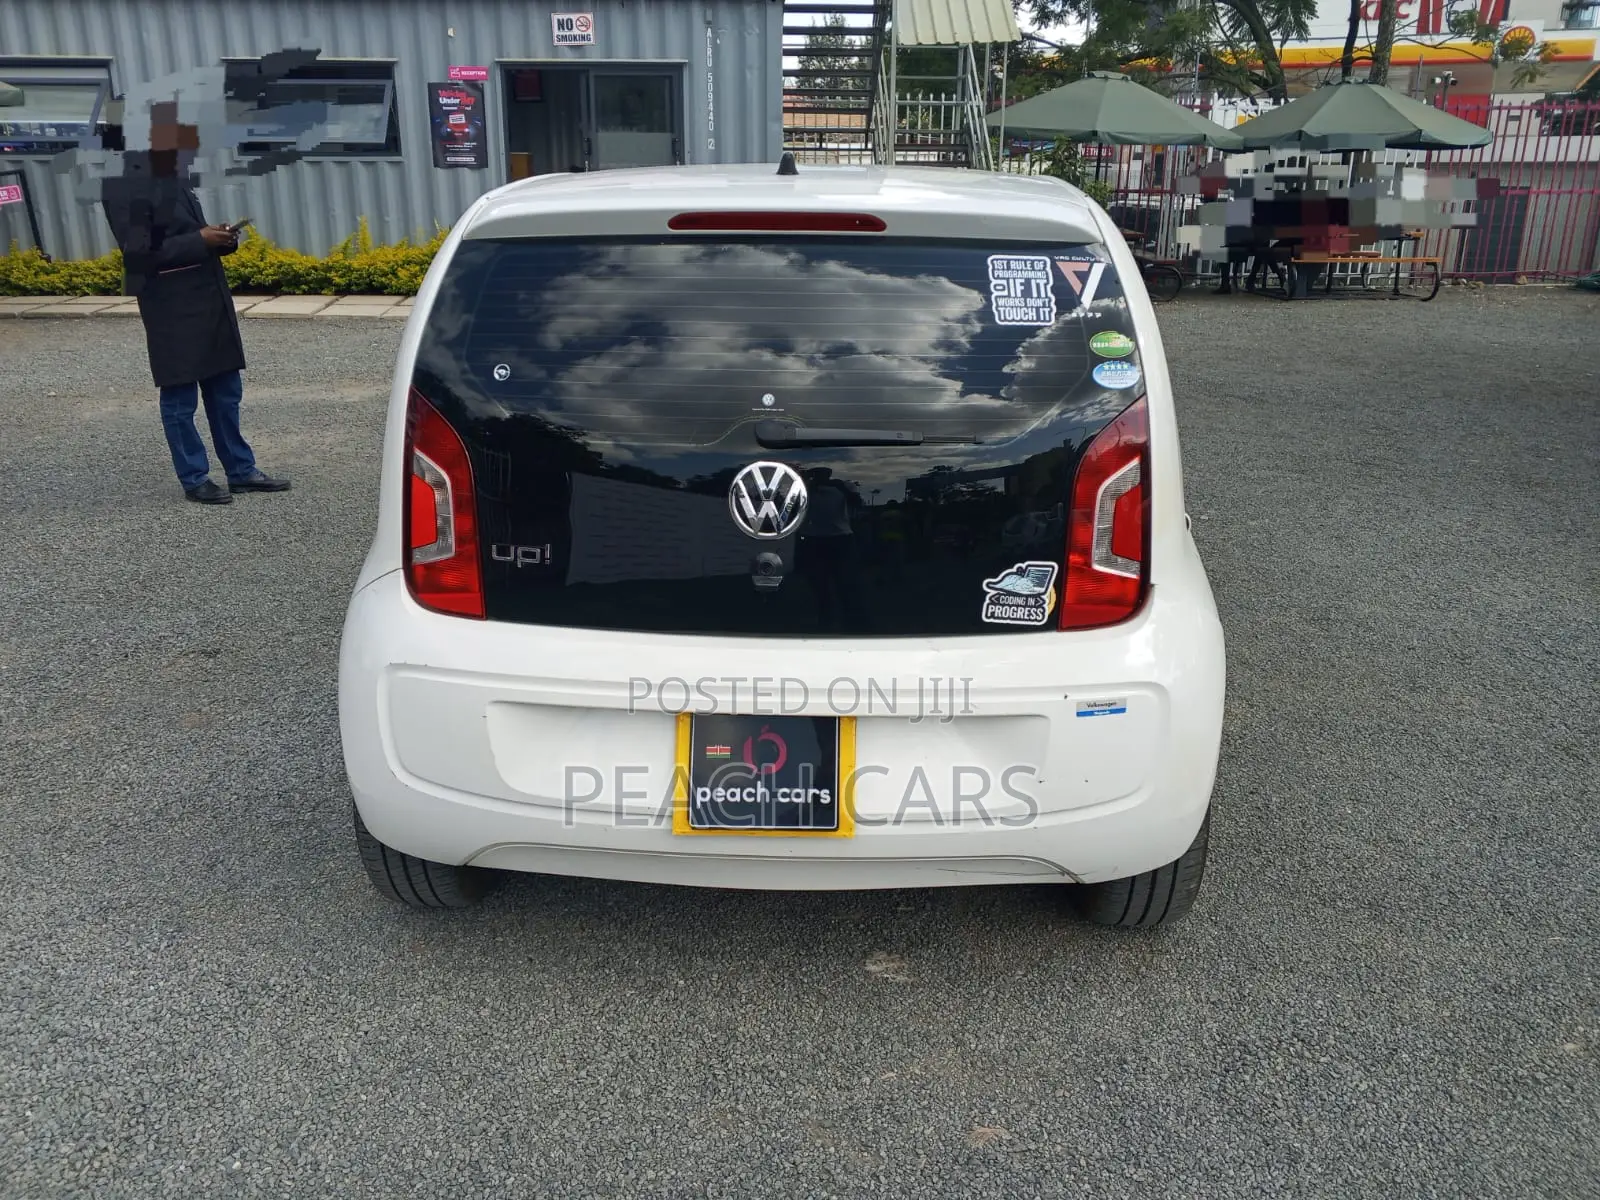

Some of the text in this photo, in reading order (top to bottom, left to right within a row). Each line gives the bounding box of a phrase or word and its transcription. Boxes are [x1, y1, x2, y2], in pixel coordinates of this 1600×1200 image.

[557, 18, 574, 31] NO
[556, 34, 592, 43] SMOKING
[439, 96, 461, 104] Under
[993, 260, 1045, 271] 1ST RULE OF
[994, 270, 1047, 279] PROGRAMMING
[1009, 278, 1048, 298] IF IT
[997, 298, 1050, 307] WORKS DON'T
[998, 307, 1051, 321] TOUCH IT
[491, 543, 550, 568] up!
[987, 605, 1044, 620] PROGRESS
[696, 780, 832, 809] peach cars
